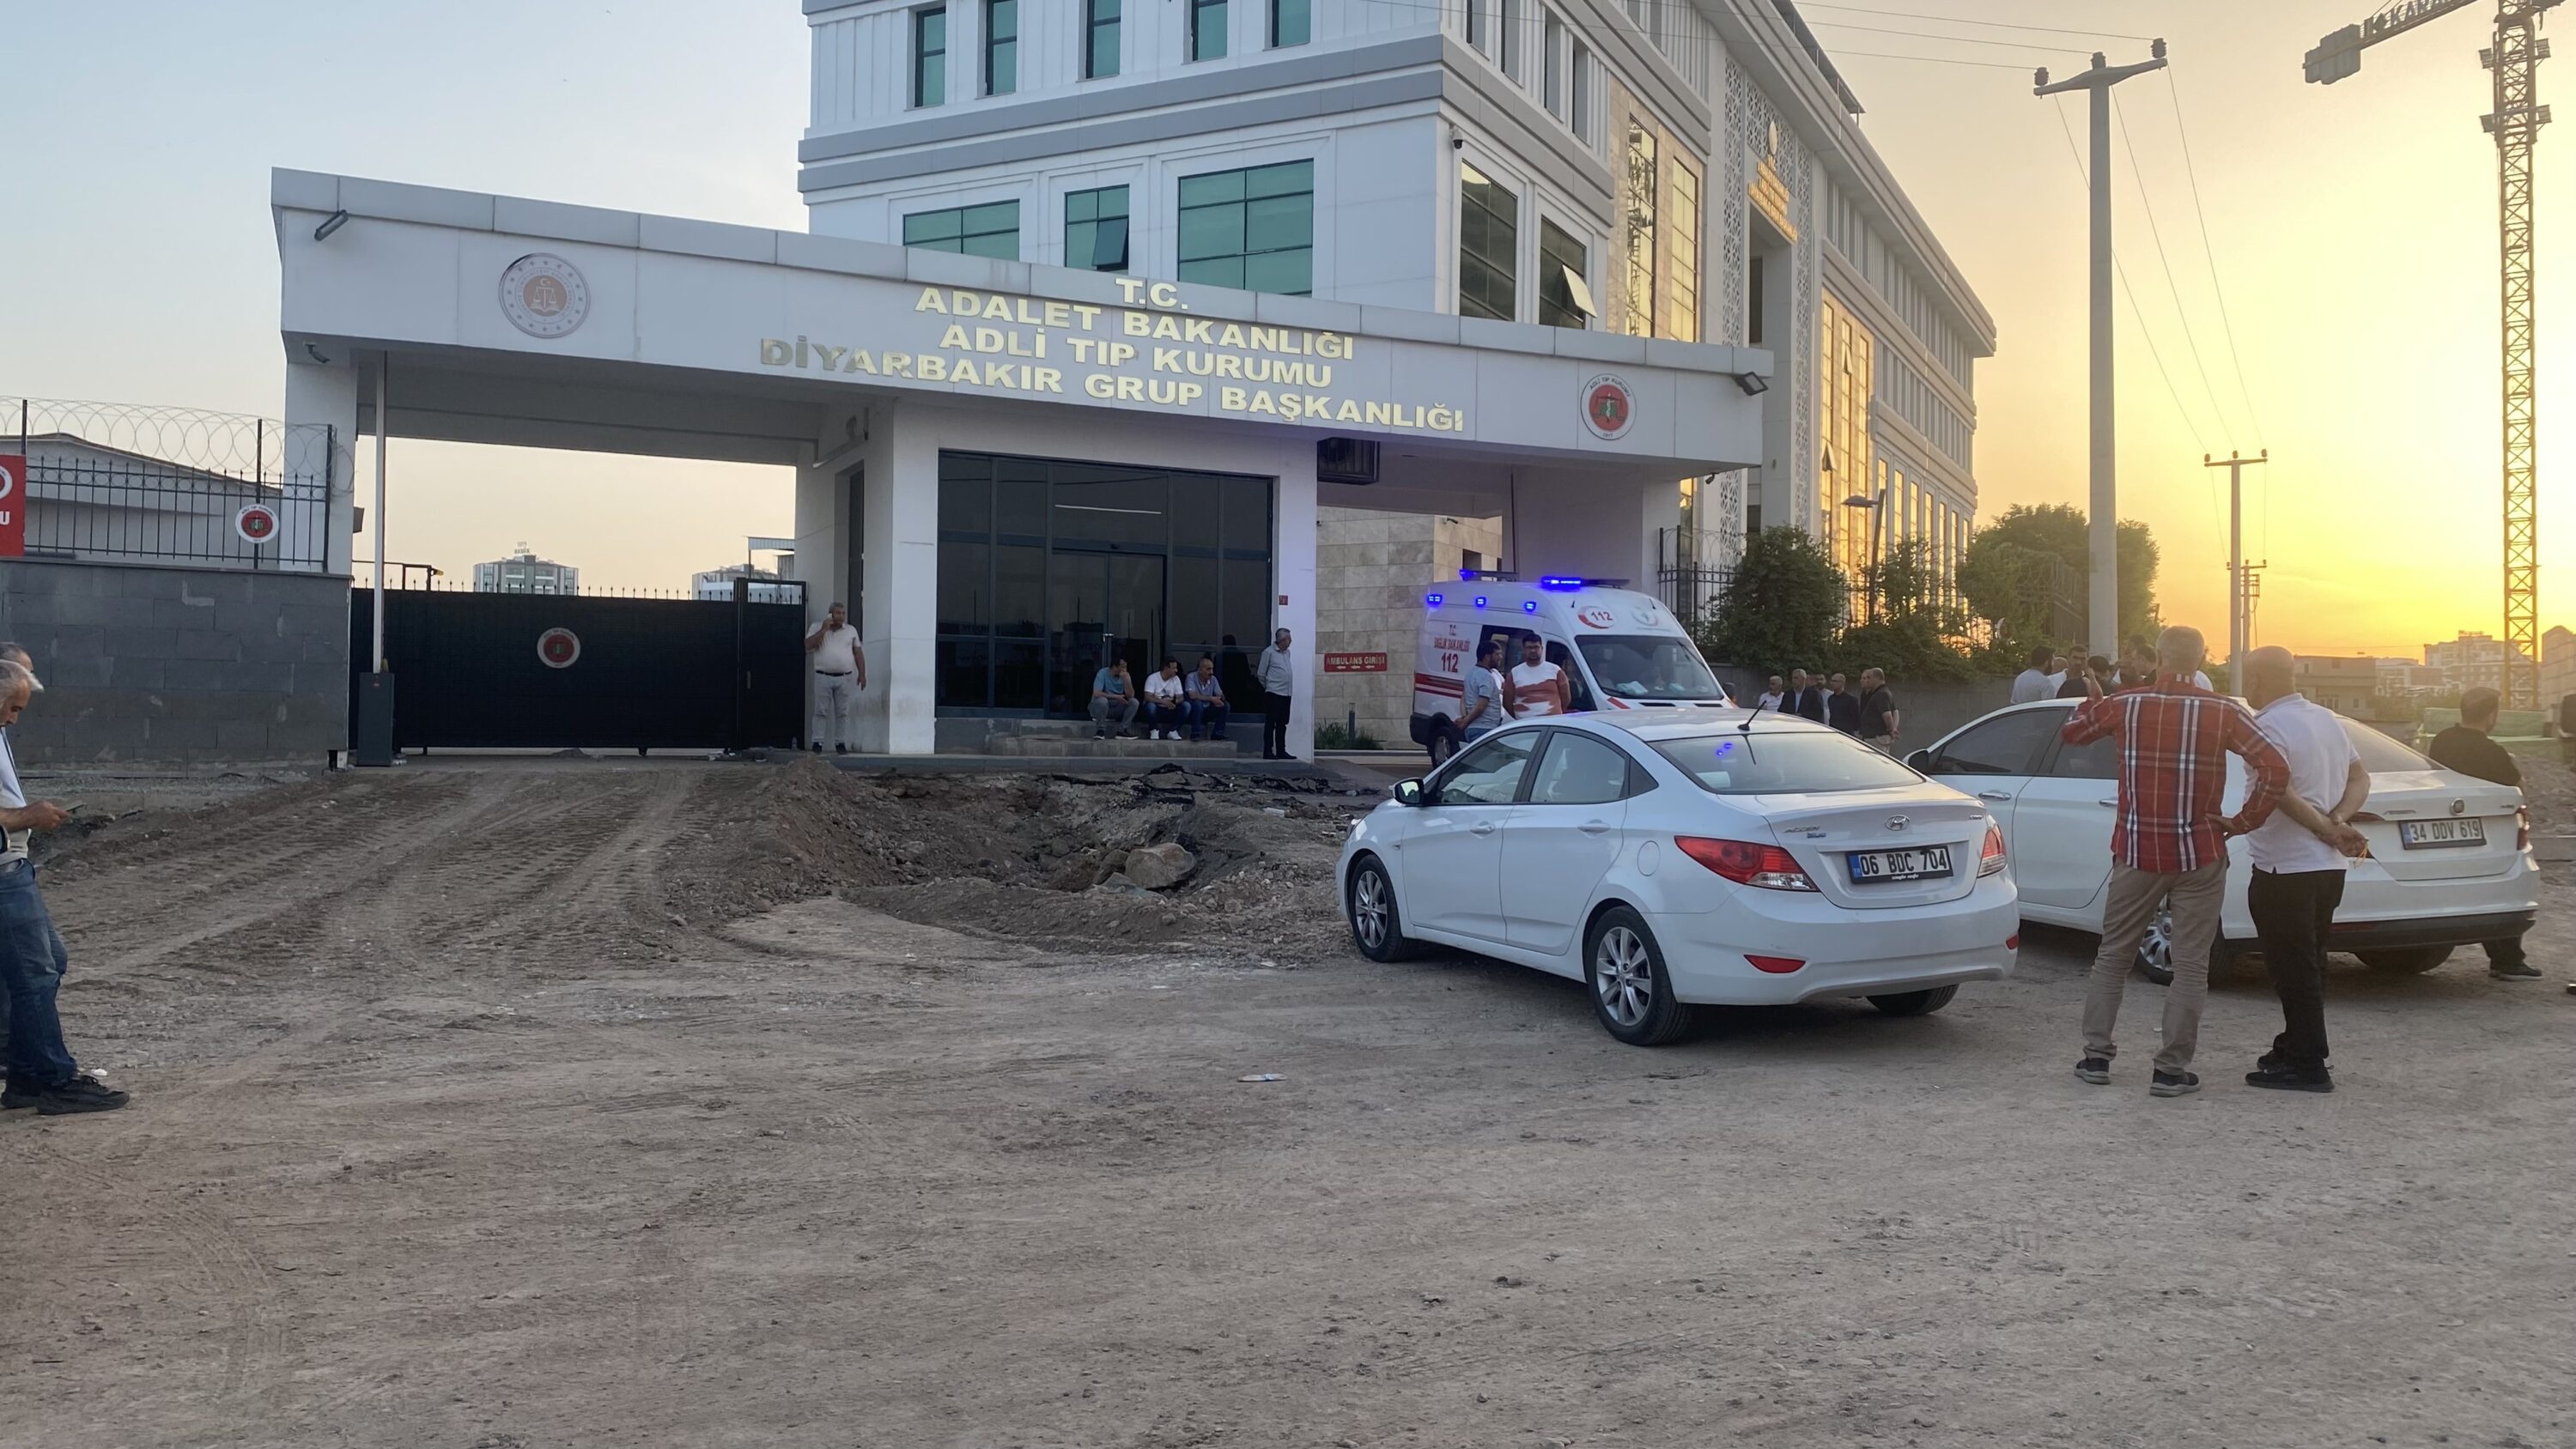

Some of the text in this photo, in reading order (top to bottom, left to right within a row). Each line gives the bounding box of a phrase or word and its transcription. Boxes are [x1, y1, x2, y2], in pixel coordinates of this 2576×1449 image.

[1115, 277, 1188, 310] T.C.
[914, 287, 1353, 361] ADALET BAKANLIĞI
[939, 324, 1332, 388] ADLİ TIP KURUMU
[760, 335, 1463, 432] DİYARBAKIR GRUP BAŞKANLIĞI
[1590, 611, 1613, 621] 112
[1326, 656, 1363, 665] AMBULANS
[1441, 652, 1459, 673] 112
[2409, 820, 2481, 841] 34 DDV 619
[1860, 848, 1947, 876] 06 BDC 704
